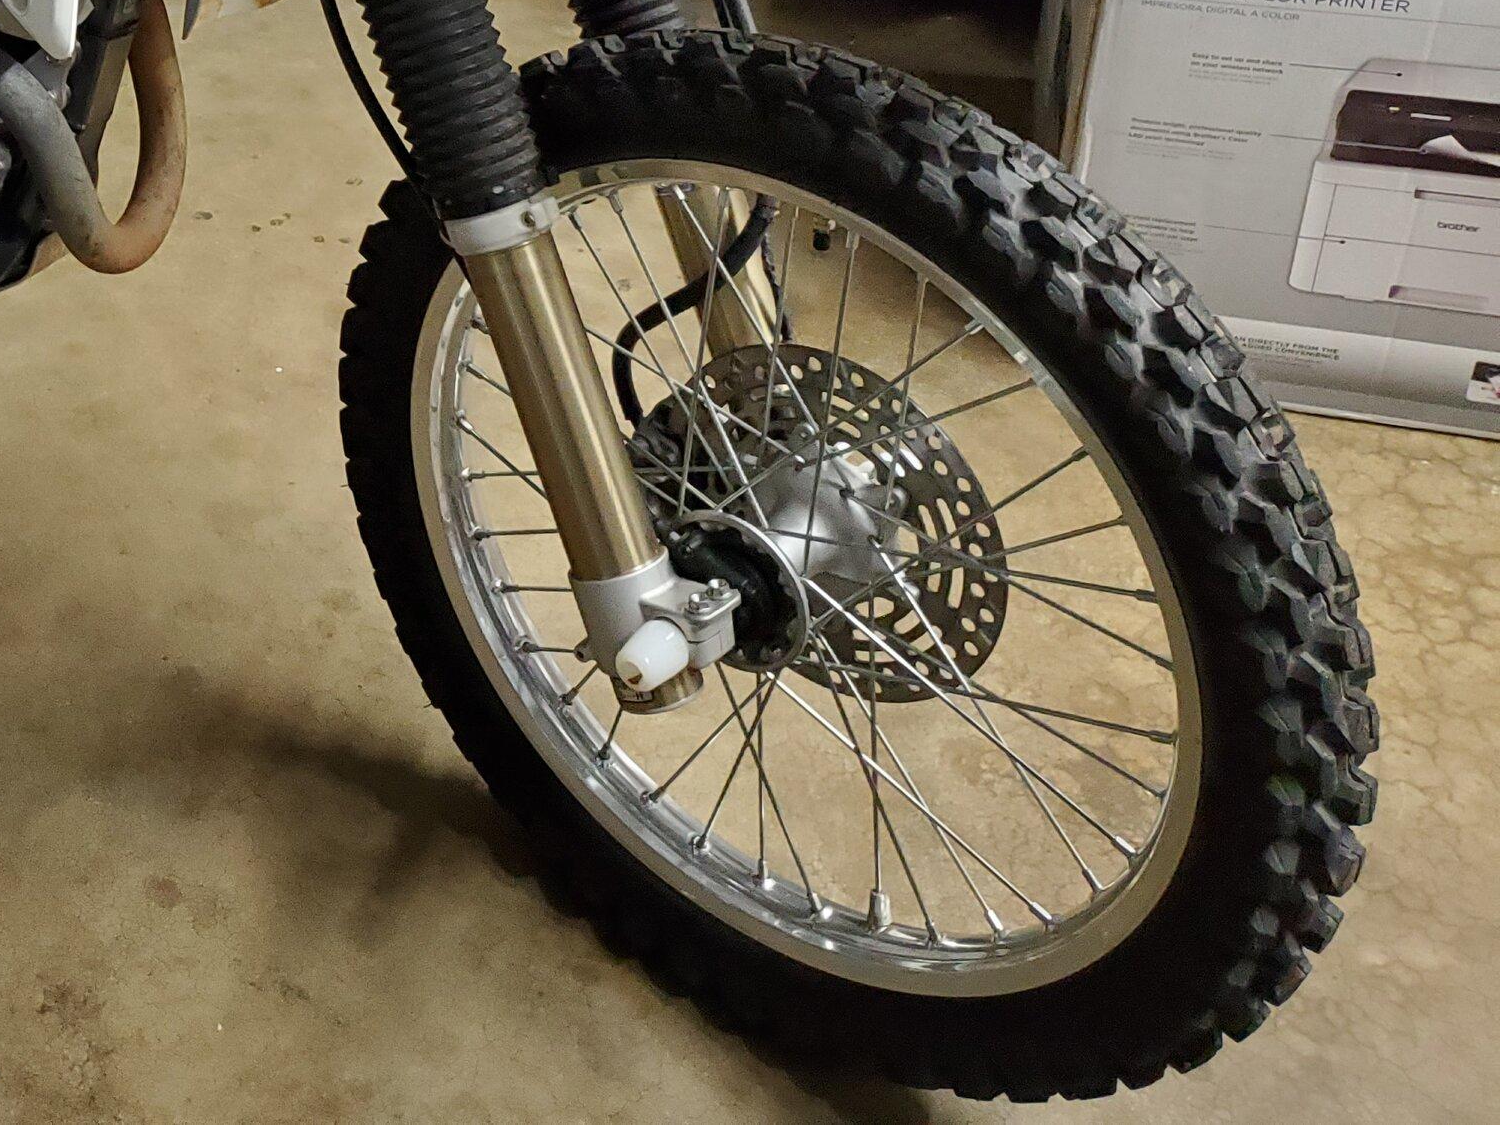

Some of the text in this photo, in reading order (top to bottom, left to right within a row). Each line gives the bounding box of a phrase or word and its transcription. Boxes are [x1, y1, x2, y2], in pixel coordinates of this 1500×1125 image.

[1141, 0, 1300, 21] IMPRESORA DIGITAL A COLOR
[1437, 220, 1481, 233] brother
